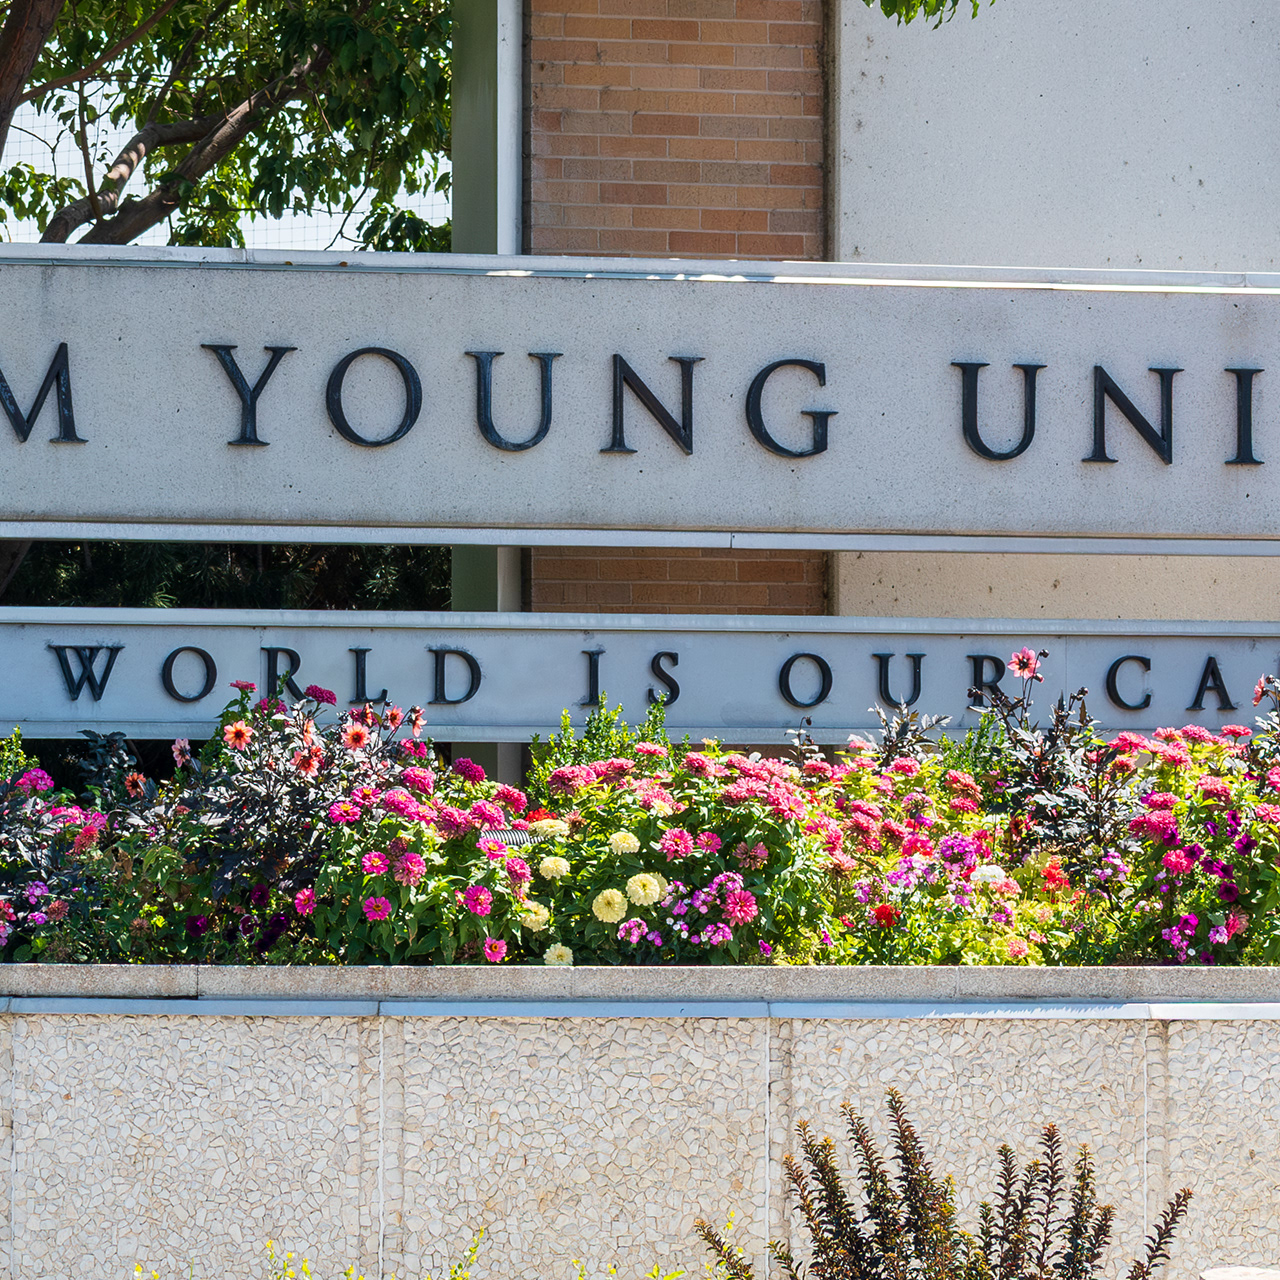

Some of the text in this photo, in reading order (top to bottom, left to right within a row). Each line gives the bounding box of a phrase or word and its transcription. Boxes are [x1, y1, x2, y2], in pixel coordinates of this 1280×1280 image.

[200, 343, 838, 459] YOUNG
[48, 644, 483, 705] WORLD
[582, 650, 680, 707] IS
[779, 652, 1017, 709] OUR
